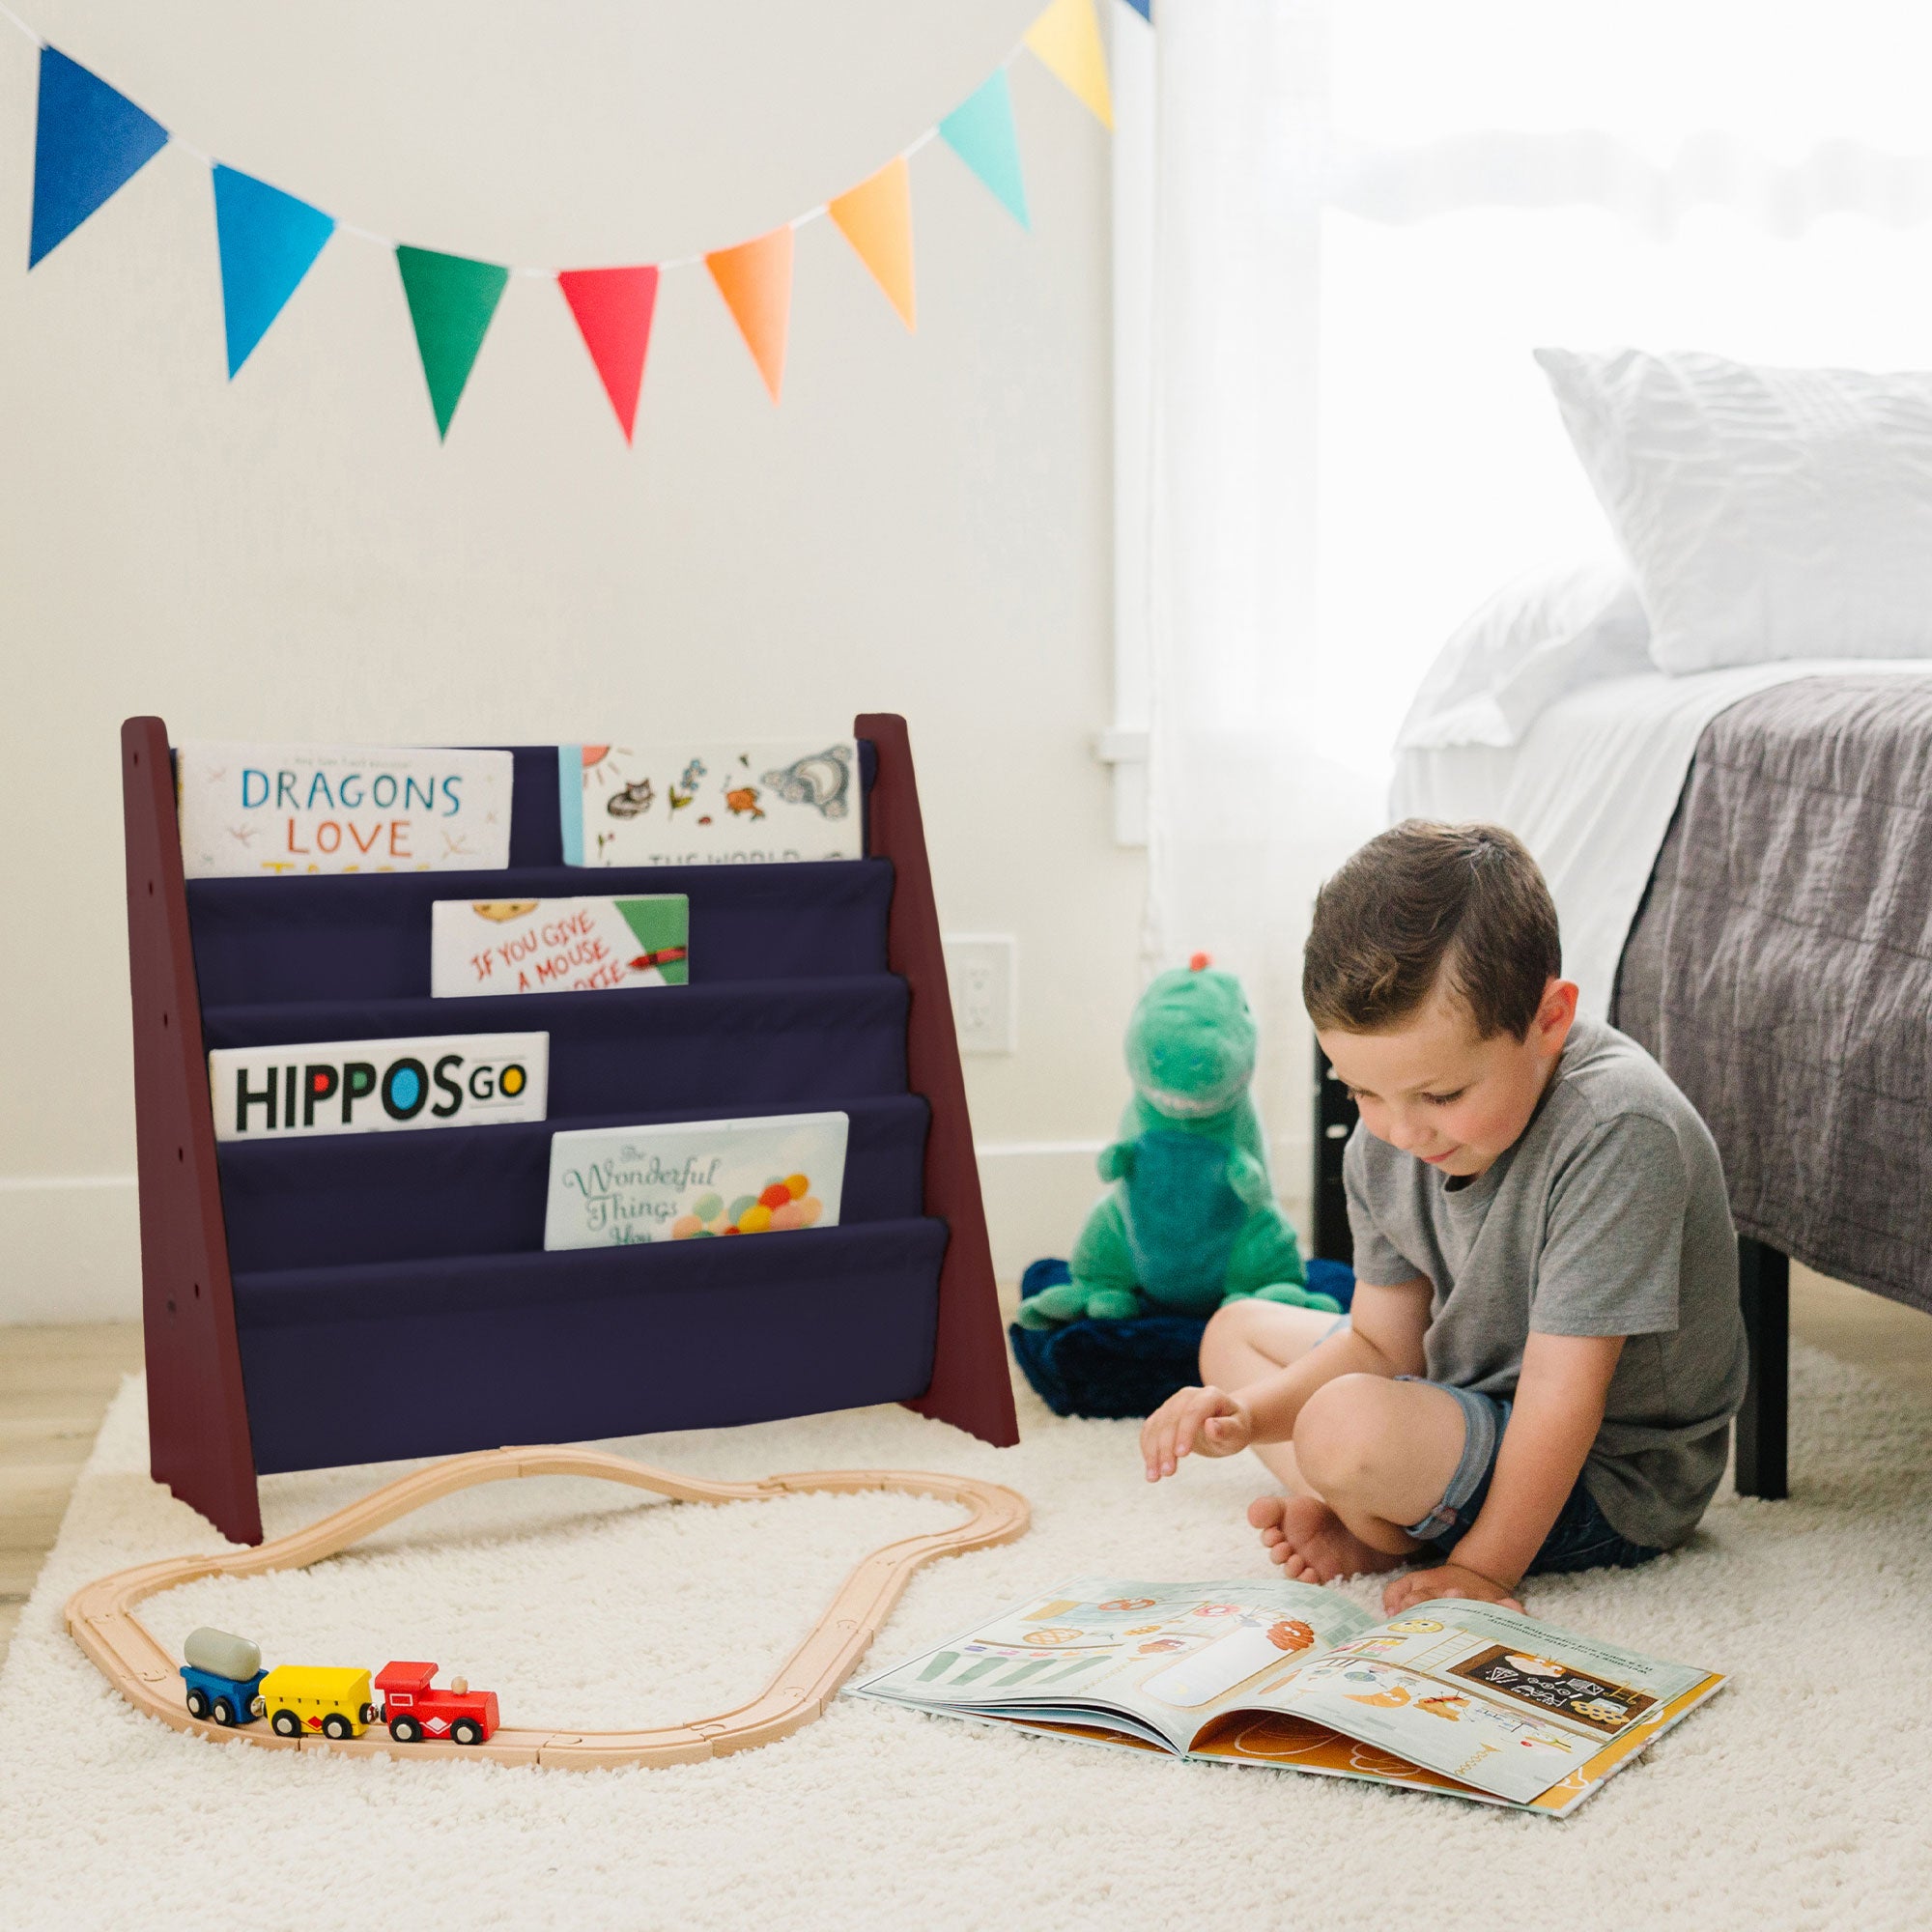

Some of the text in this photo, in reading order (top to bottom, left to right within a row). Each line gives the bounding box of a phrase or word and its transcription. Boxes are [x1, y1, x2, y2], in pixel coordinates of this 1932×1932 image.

[242, 769, 463, 817] DRAGONS
[288, 819, 412, 857] LOVE
[471, 908, 595, 980] IF YOU GIVE
[519, 939, 611, 993] A MOUSE
[237, 1054, 527, 1131] HIPPOS GO
[561, 1156, 722, 1197] Wonderful
[584, 1192, 677, 1232] Things
